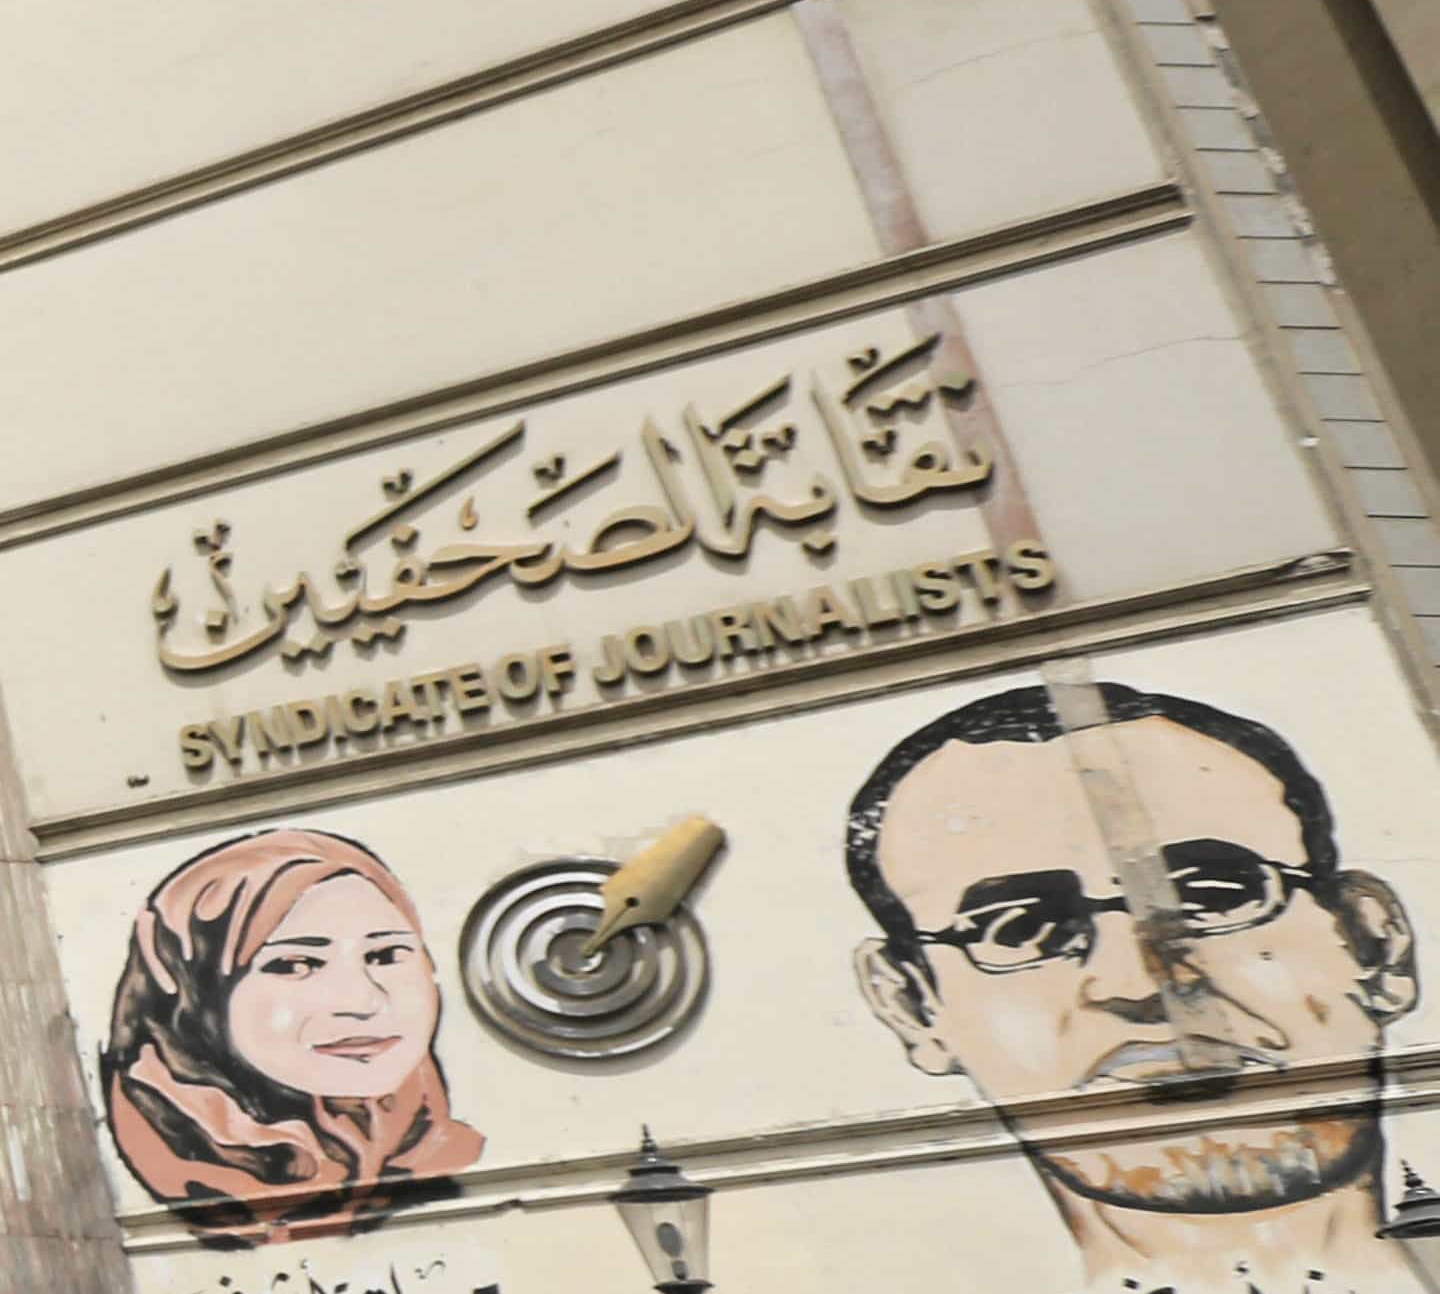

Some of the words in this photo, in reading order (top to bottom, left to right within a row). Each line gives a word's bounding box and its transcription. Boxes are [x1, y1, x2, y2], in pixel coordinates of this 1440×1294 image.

[180, 663, 490, 771] SYNDICATE
[498, 643, 576, 701] OF
[592, 539, 1057, 686] JOURNALISTS
